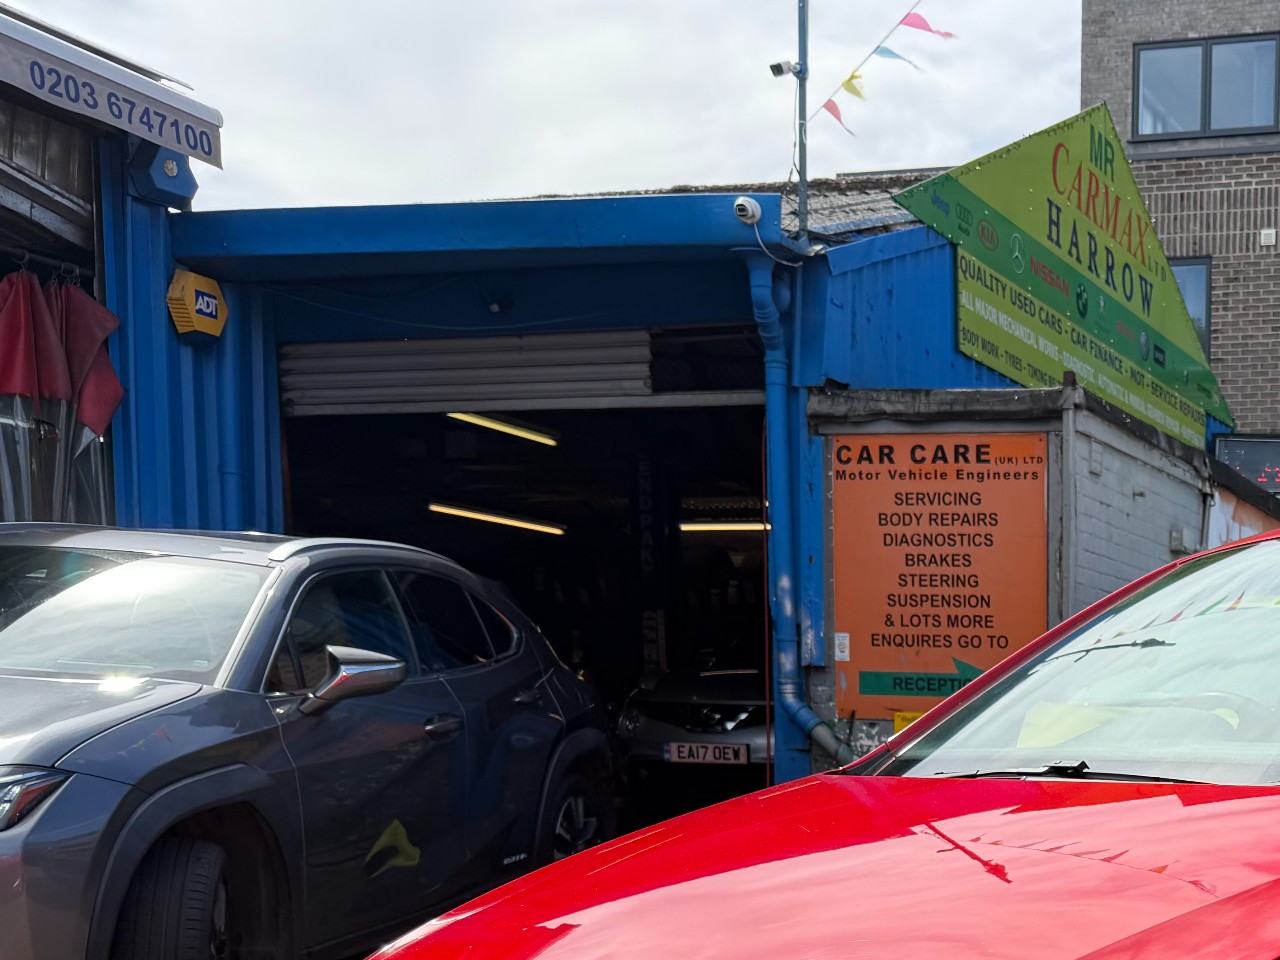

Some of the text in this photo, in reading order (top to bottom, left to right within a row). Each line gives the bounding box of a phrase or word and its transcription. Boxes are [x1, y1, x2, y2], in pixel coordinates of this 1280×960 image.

[29, 60, 213, 157] 0203 6747100
[1090, 124, 1115, 182] MR
[1052, 143, 1167, 282] CARMAX LTD
[1046, 197, 1154, 317] HARROW
[1030, 256, 1070, 297] NISSAN
[960, 255, 1007, 300] QUALITY
[1010, 287, 1036, 318] USED
[1038, 307, 1062, 335] CARS
[1071, 327, 1087, 352] CAR
[1090, 340, 1123, 376] FINANCE
[962, 326, 980, 346] BODY
[981, 337, 999, 359] WORK
[1004, 350, 1023, 373] TYRES
[836, 444, 1043, 466] CAR CARE (UK) LTD
[836, 469, 1039, 483] Motor Vehicle Engineers
[894, 492, 982, 506] SERVICING
[878, 512, 999, 527] BODY REPAIRS
[883, 533, 994, 547] DIAGNOSTICS
[905, 554, 972, 568] BRAKES
[898, 573, 979, 588] STEERING
[887, 594, 991, 608] SUSPENSION
[884, 614, 994, 628] & LOTS MORE
[871, 634, 1009, 649] ENQUIRES GO TO
[677, 745, 740, 761] EA17 OEW
